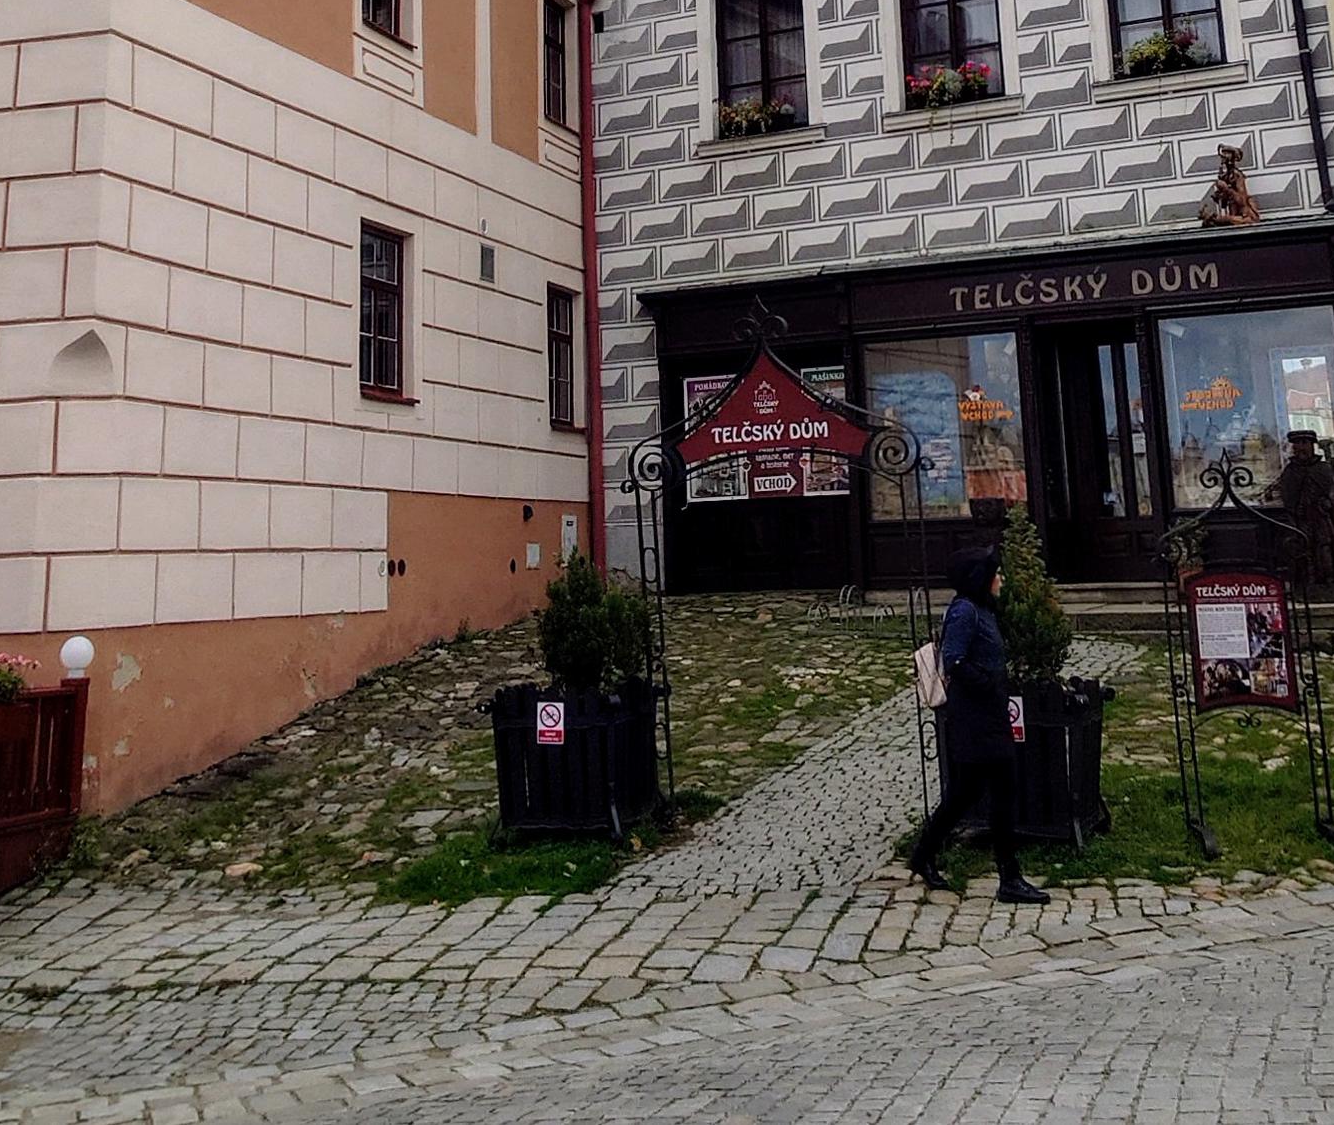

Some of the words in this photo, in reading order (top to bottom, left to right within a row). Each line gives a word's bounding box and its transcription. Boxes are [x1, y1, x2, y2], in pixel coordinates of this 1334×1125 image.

[949, 266, 1107, 311] TELČSKÝ
[1131, 259, 1219, 295] DŮM
[711, 419, 785, 444] TELČSKÝ
[789, 417, 829, 440] DŮM
[756, 477, 792, 490] VCHOD
[1196, 584, 1240, 596] TELČSKÝ
[1243, 584, 1266, 595] DŮM
